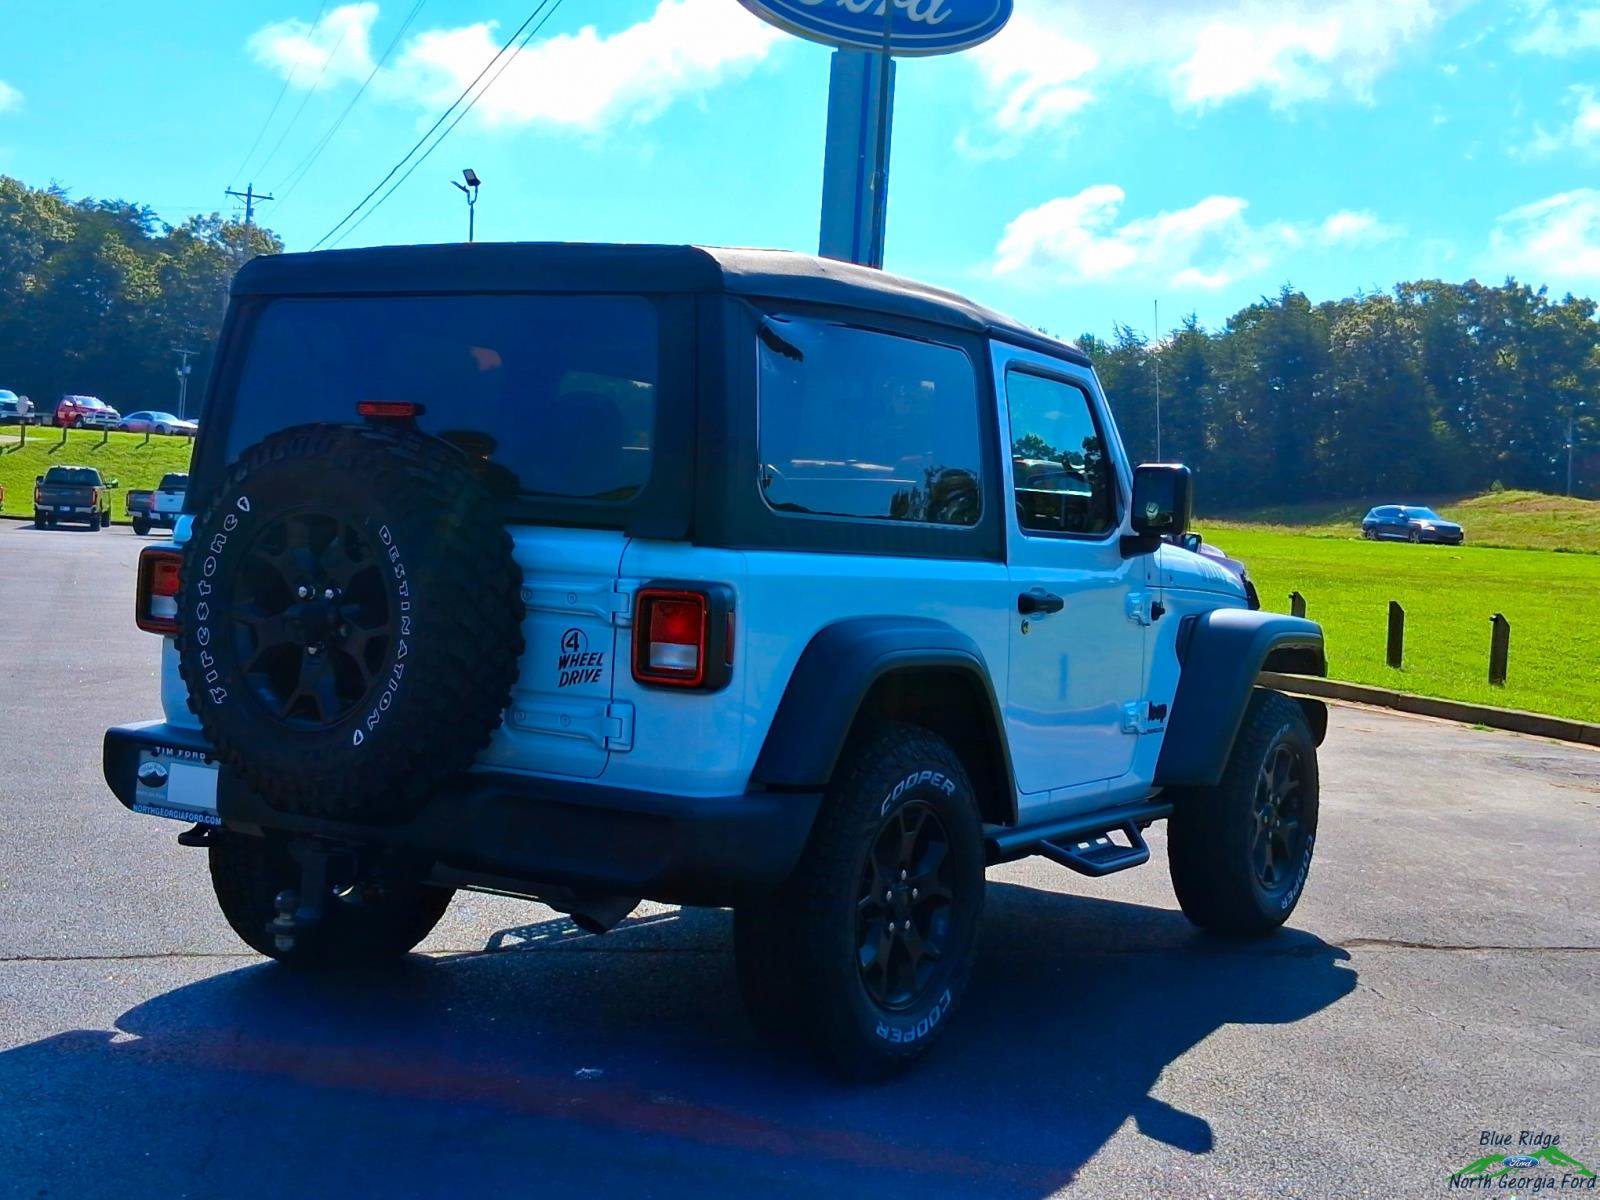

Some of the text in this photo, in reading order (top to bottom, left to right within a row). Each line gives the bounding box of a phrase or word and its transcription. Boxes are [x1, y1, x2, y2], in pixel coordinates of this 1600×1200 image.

[797, 0, 953, 25] ord
[196, 514, 239, 704] Firestone
[366, 524, 411, 731] DESTINATION
[558, 651, 604, 671] WHEEL
[558, 668, 603, 688] DRIVE
[178, 749, 206, 760] FORD
[881, 770, 956, 816] COOPER
[1280, 834, 1313, 910] COOPER
[876, 988, 952, 1043] COOPER
